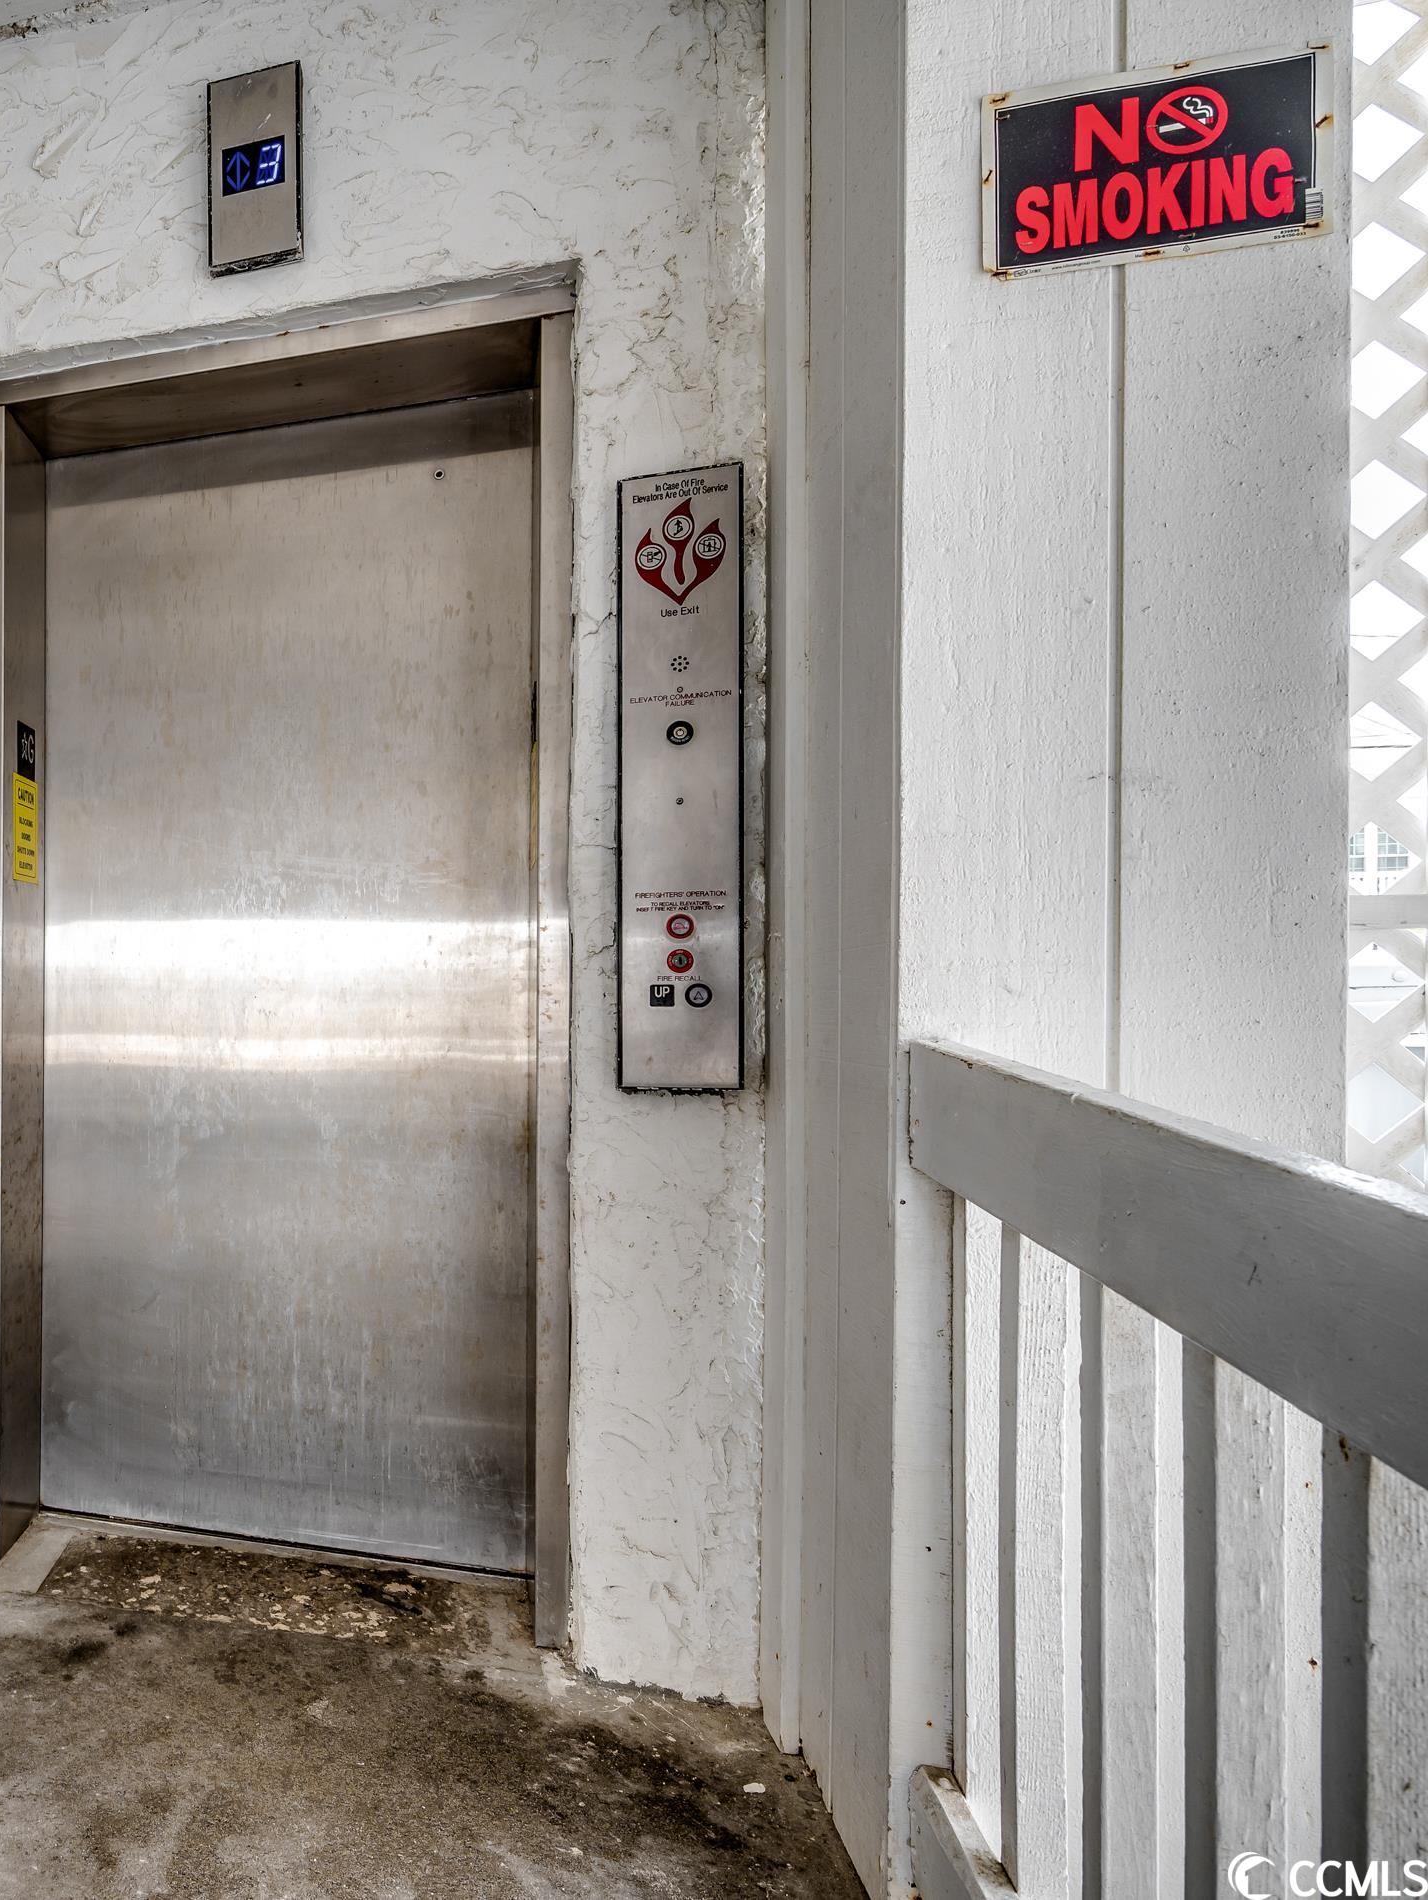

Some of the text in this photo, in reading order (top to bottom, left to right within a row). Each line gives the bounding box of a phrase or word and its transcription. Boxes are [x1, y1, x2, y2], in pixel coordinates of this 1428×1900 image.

[256, 143, 282, 185] 3
[1015, 147, 1294, 254] SMOKING
[655, 478, 705, 492] In Case Of Fire
[632, 483, 729, 504] Elevators Are Out Of Service
[660, 605, 700, 617] Use Exit
[629, 689, 732, 704] ELEVATOR COMMUNICATION
[665, 699, 695, 707] FAILURE
[18, 786, 34, 805] CAUTION
[634, 891, 685, 899] FIREFIGHTERS'
[654, 986, 670, 998] UP
